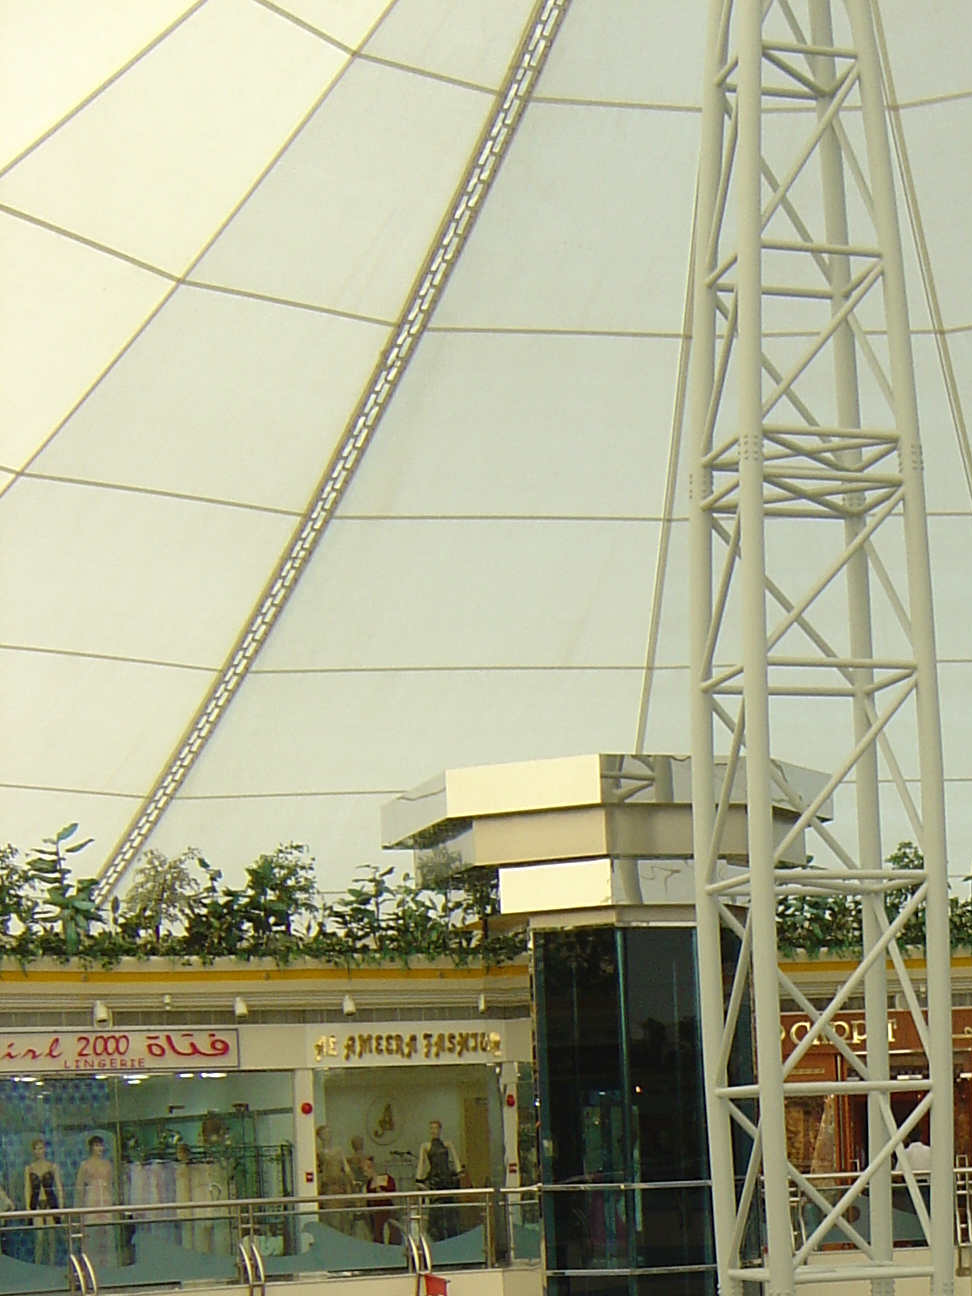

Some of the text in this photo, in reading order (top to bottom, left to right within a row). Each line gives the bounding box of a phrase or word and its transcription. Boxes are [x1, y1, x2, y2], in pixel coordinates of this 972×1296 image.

[789, 1018, 898, 1046] CRPT
[0, 1035, 130, 1060] irl 2000
[146, 1033, 230, 1058] فتاة
[344, 1033, 418, 1060] AMEERA
[422, 1032, 502, 1058] FASHION
[64, 1057, 146, 1069] LINGERIE
